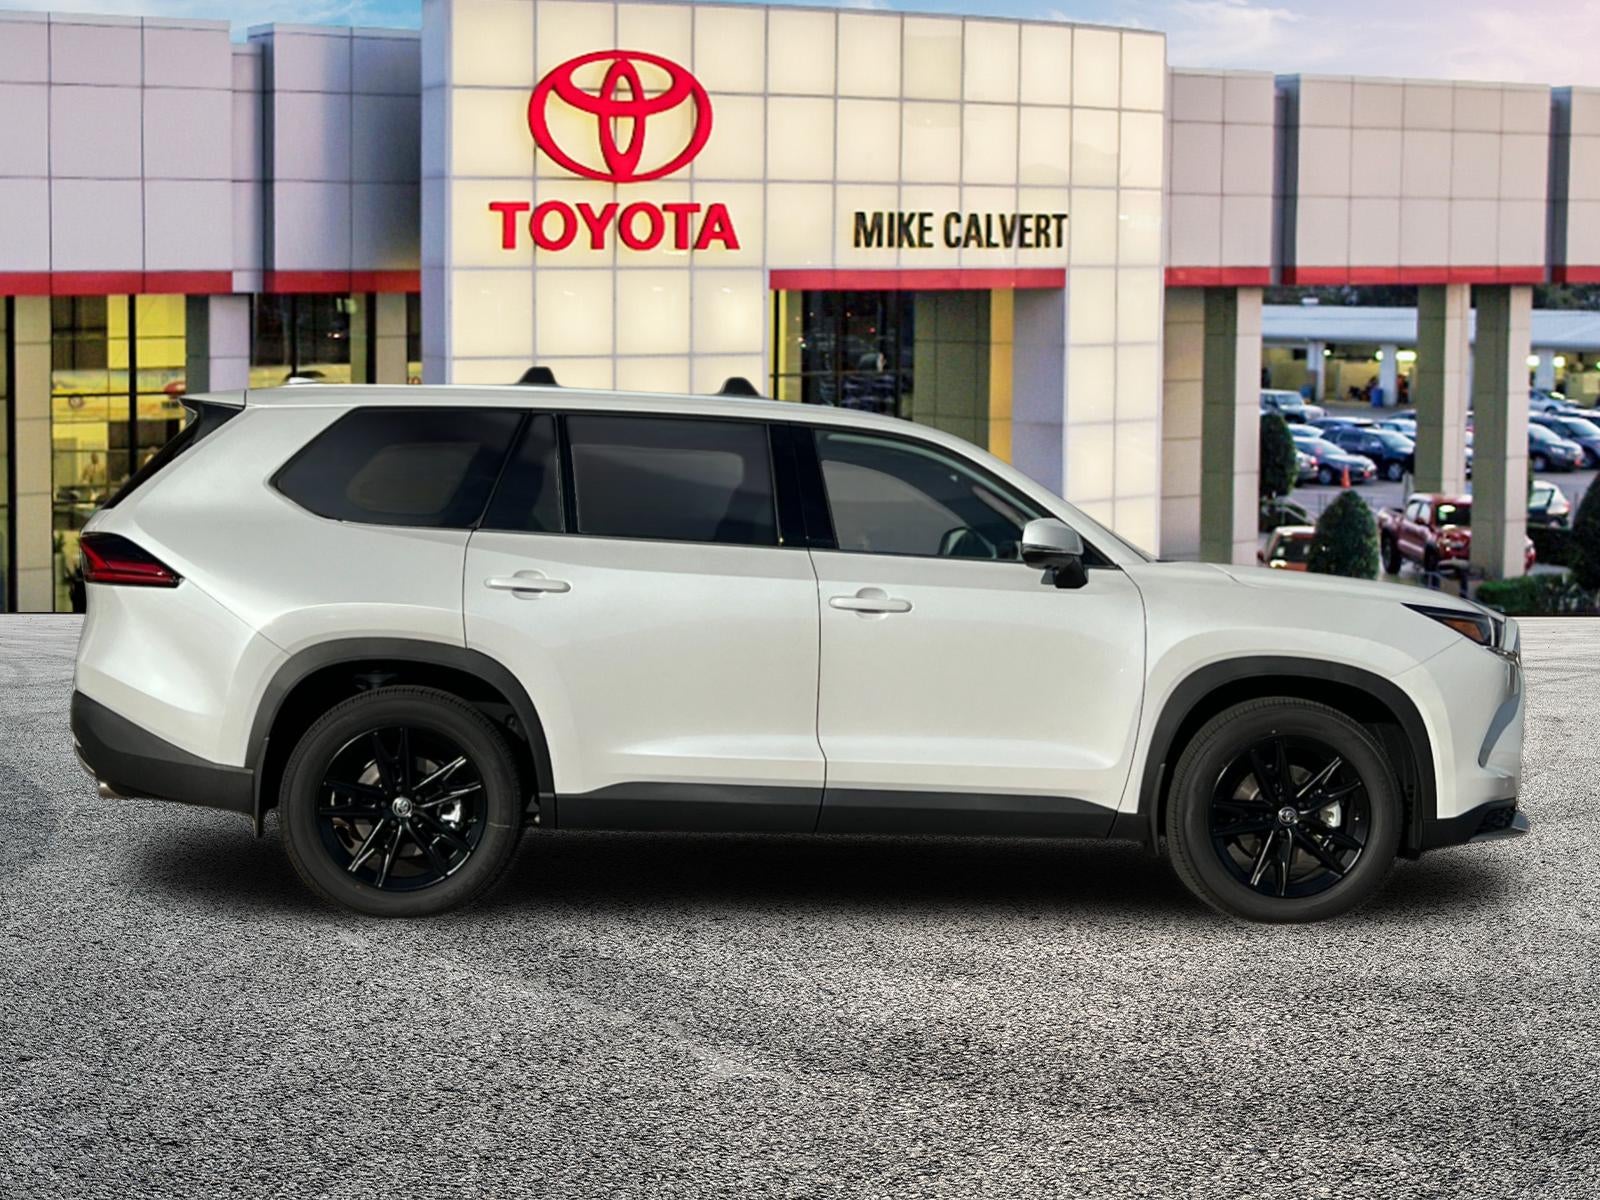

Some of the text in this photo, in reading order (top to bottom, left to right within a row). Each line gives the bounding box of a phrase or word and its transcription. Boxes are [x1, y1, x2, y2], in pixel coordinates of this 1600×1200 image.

[489, 200, 740, 251] TOYOTA
[854, 211, 1068, 248] MIKE CALVERT
